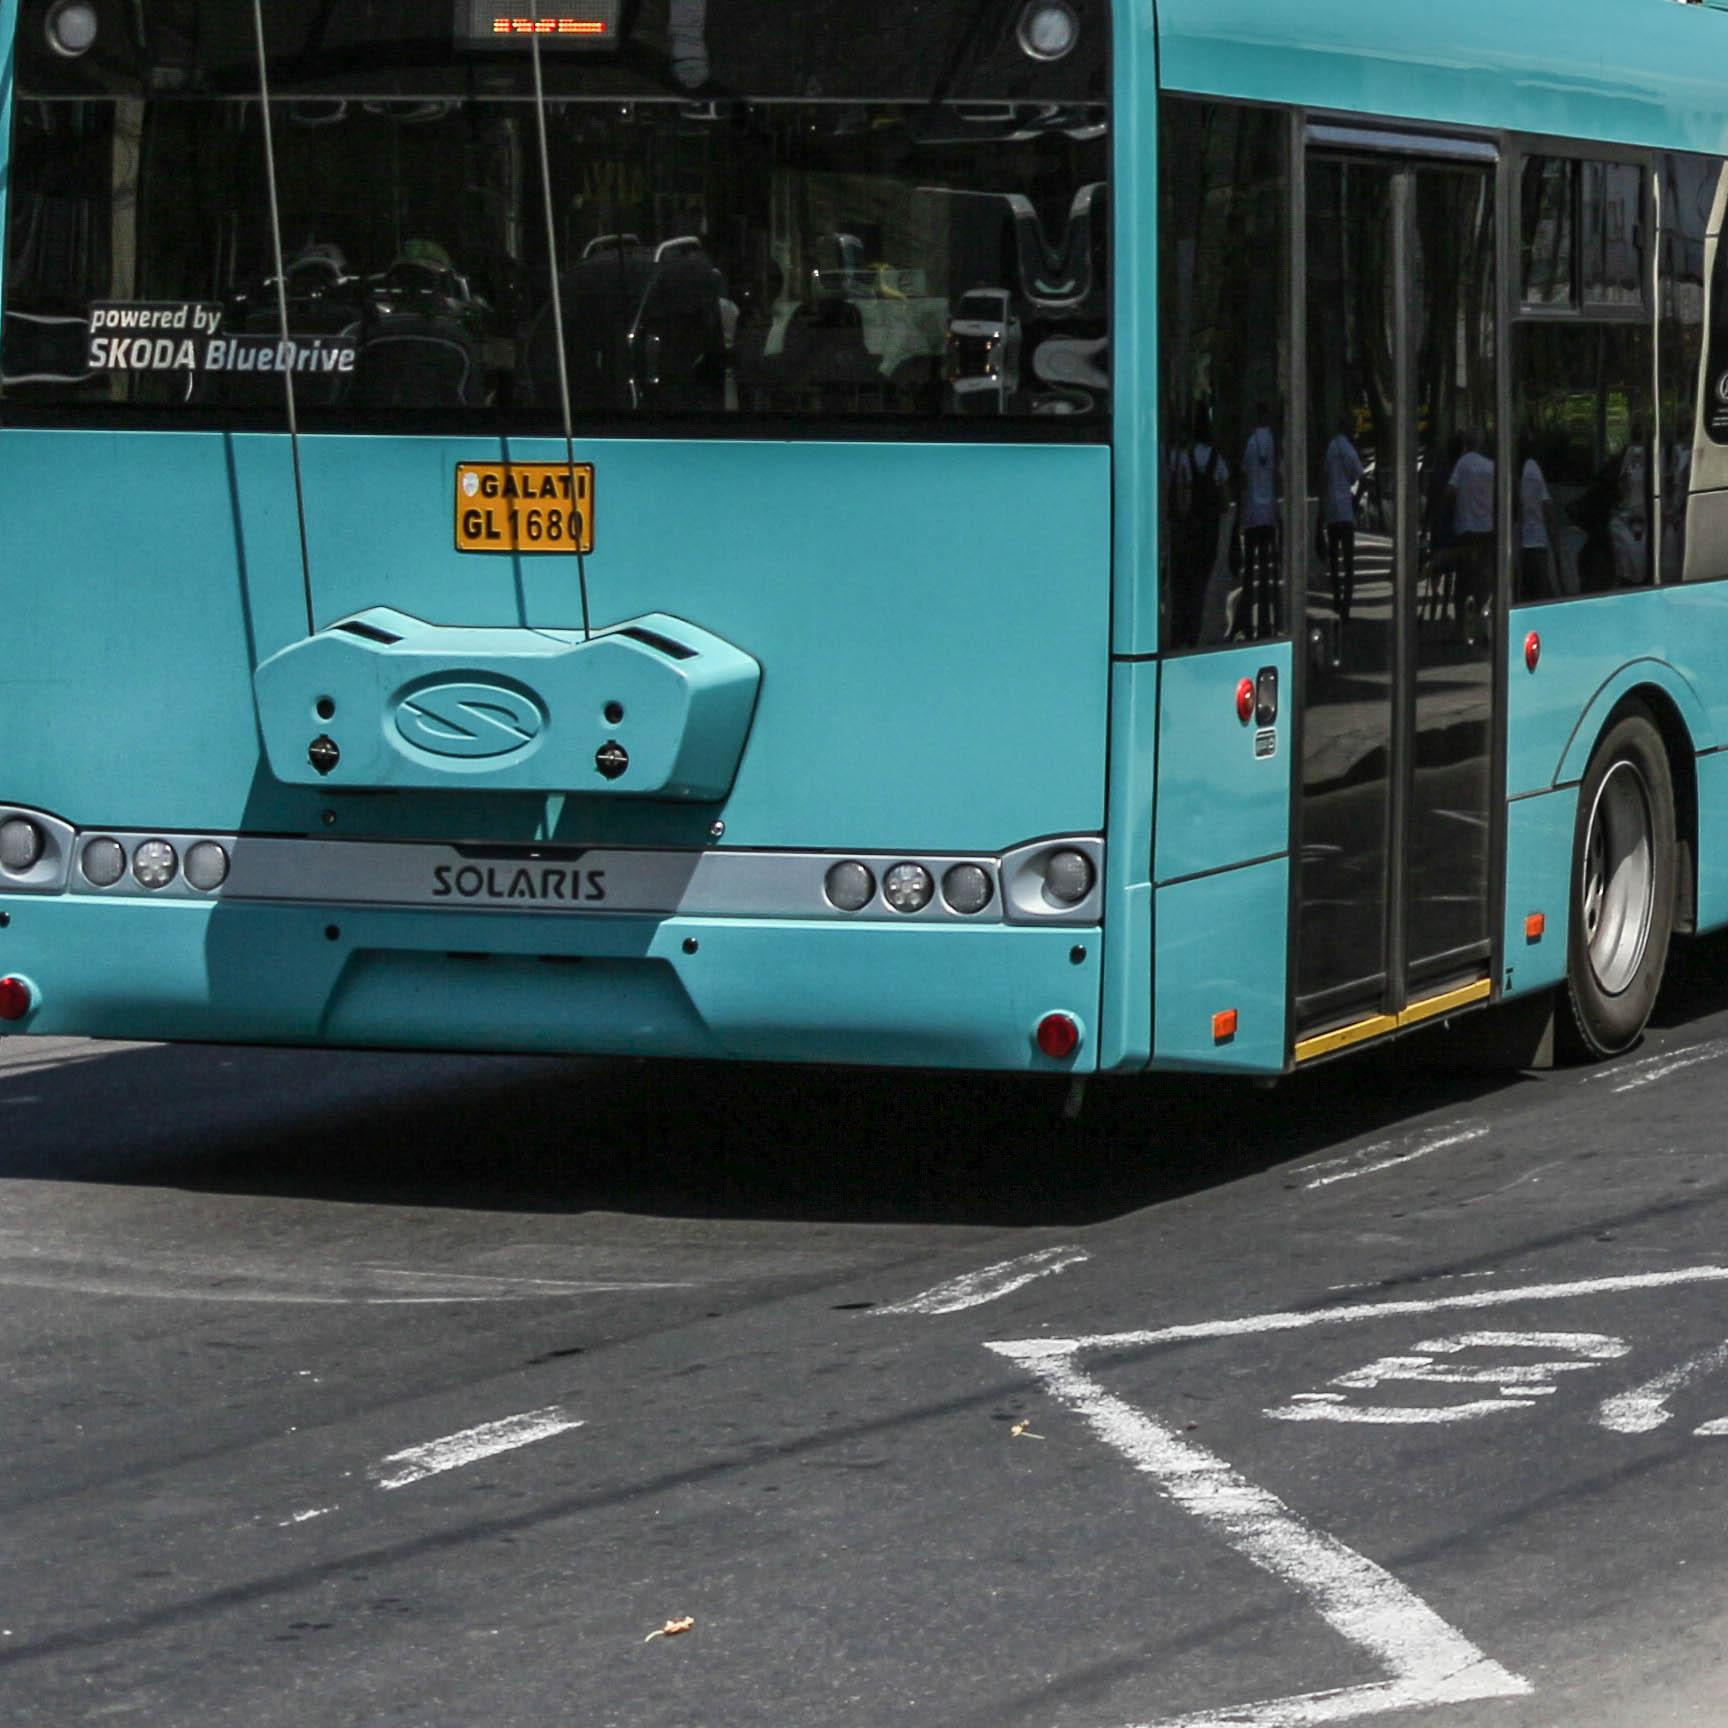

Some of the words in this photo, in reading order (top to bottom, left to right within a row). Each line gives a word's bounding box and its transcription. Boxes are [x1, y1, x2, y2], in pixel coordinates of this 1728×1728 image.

[90, 305, 188, 333] powered
[192, 305, 222, 335] by
[89, 337, 196, 369] SKODA
[205, 339, 355, 372] BlueDrive
[480, 474, 587, 499] GALATI
[462, 508, 500, 540] GL
[509, 508, 583, 541] 1680
[432, 865, 606, 901] SOLARIS
